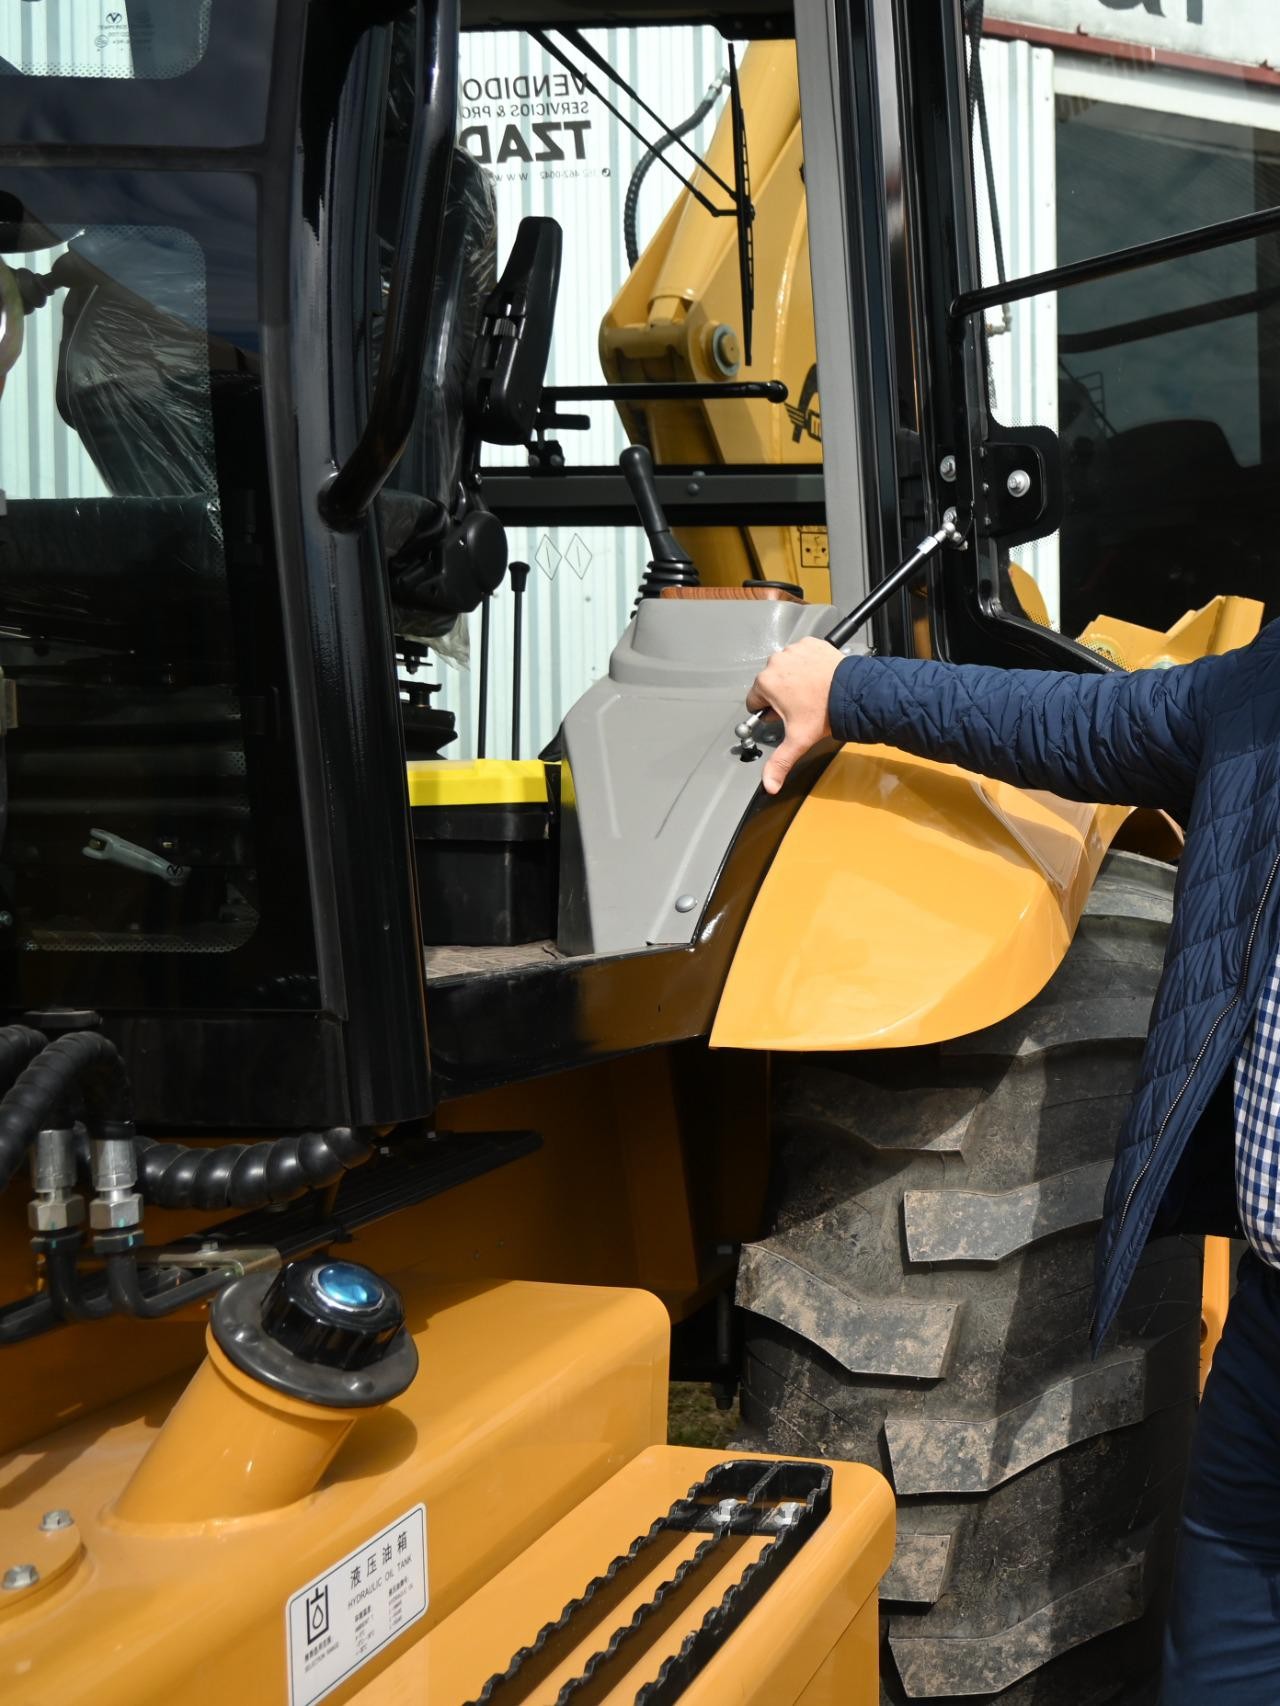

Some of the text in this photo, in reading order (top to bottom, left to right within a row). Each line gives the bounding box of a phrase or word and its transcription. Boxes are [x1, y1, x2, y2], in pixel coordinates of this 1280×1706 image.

[348, 1577, 383, 1610] HYDRAULIC
[384, 1569, 394, 1581] OIL
[397, 1555, 413, 1572] TANK
